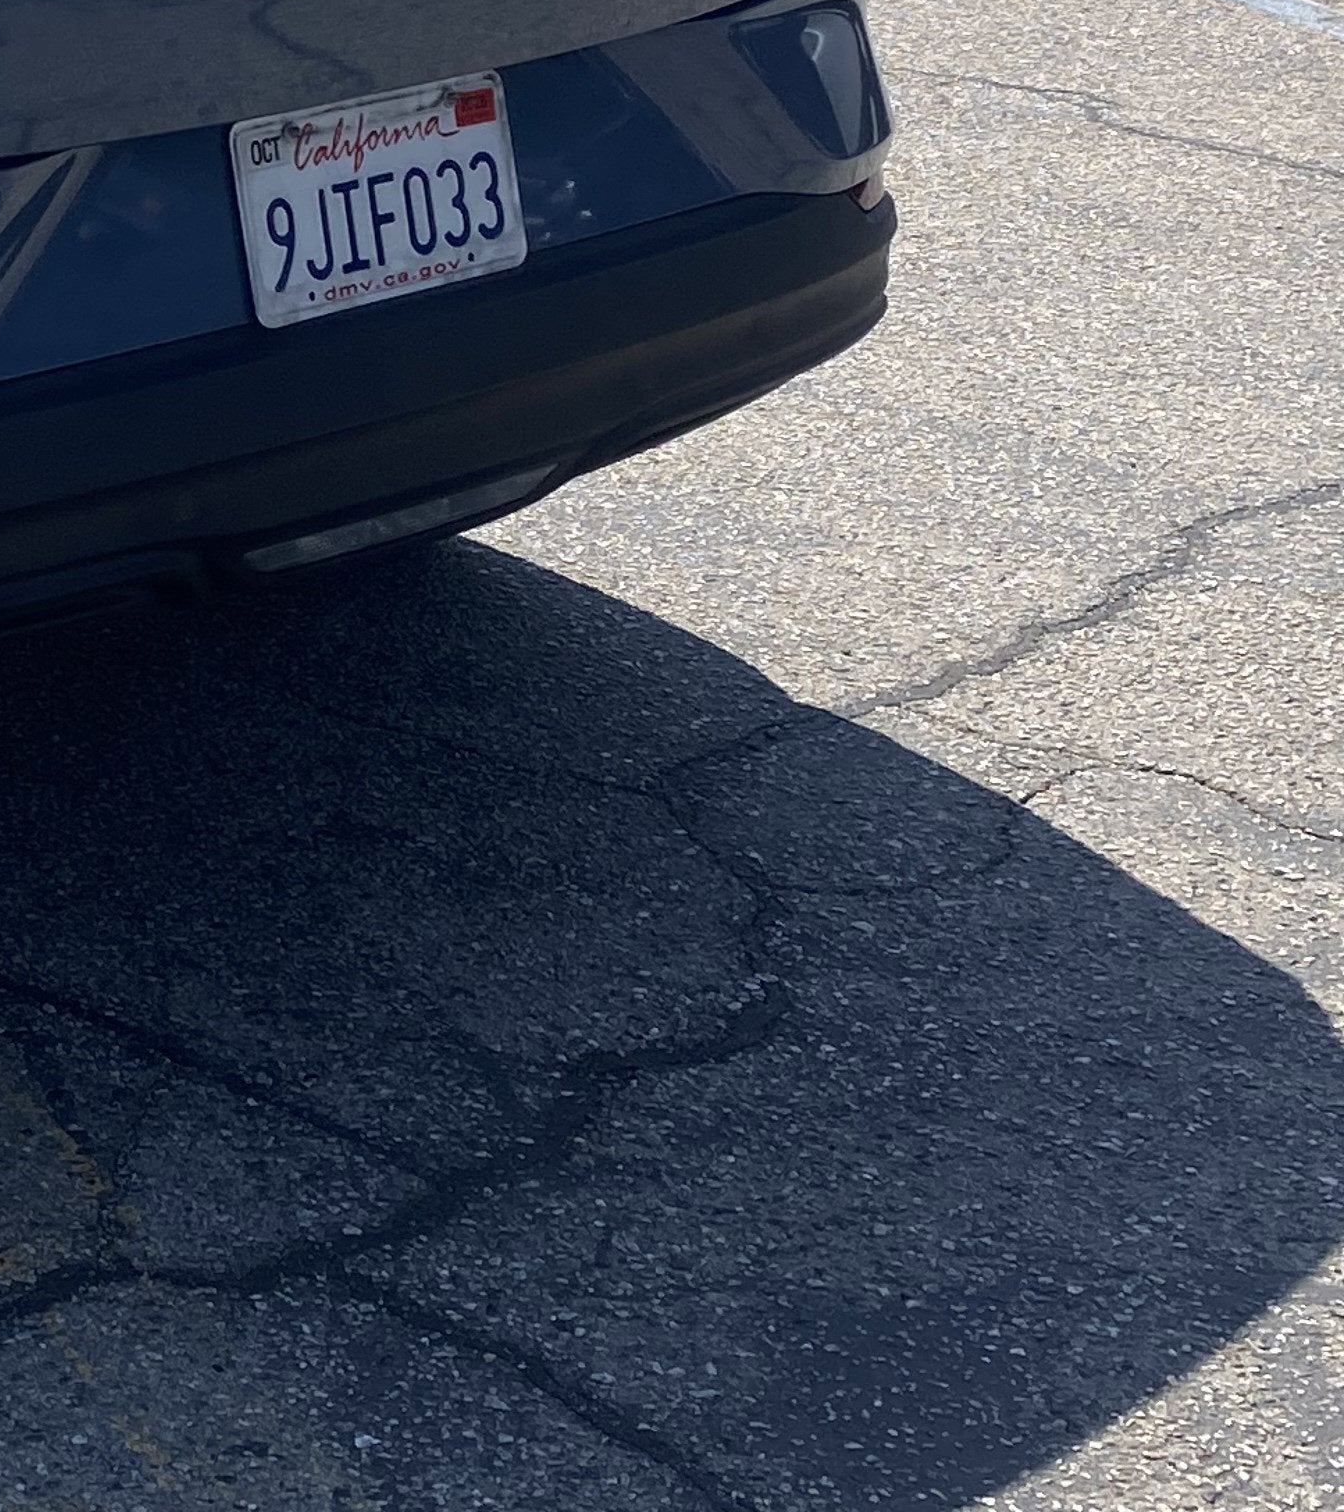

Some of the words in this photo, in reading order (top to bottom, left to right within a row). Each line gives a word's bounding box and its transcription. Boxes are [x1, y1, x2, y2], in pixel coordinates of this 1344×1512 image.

[252, 136, 281, 166] OCT
[293, 114, 460, 172] California
[266, 152, 506, 293] 9JIF033
[324, 257, 462, 302] dmv.ca.gov
